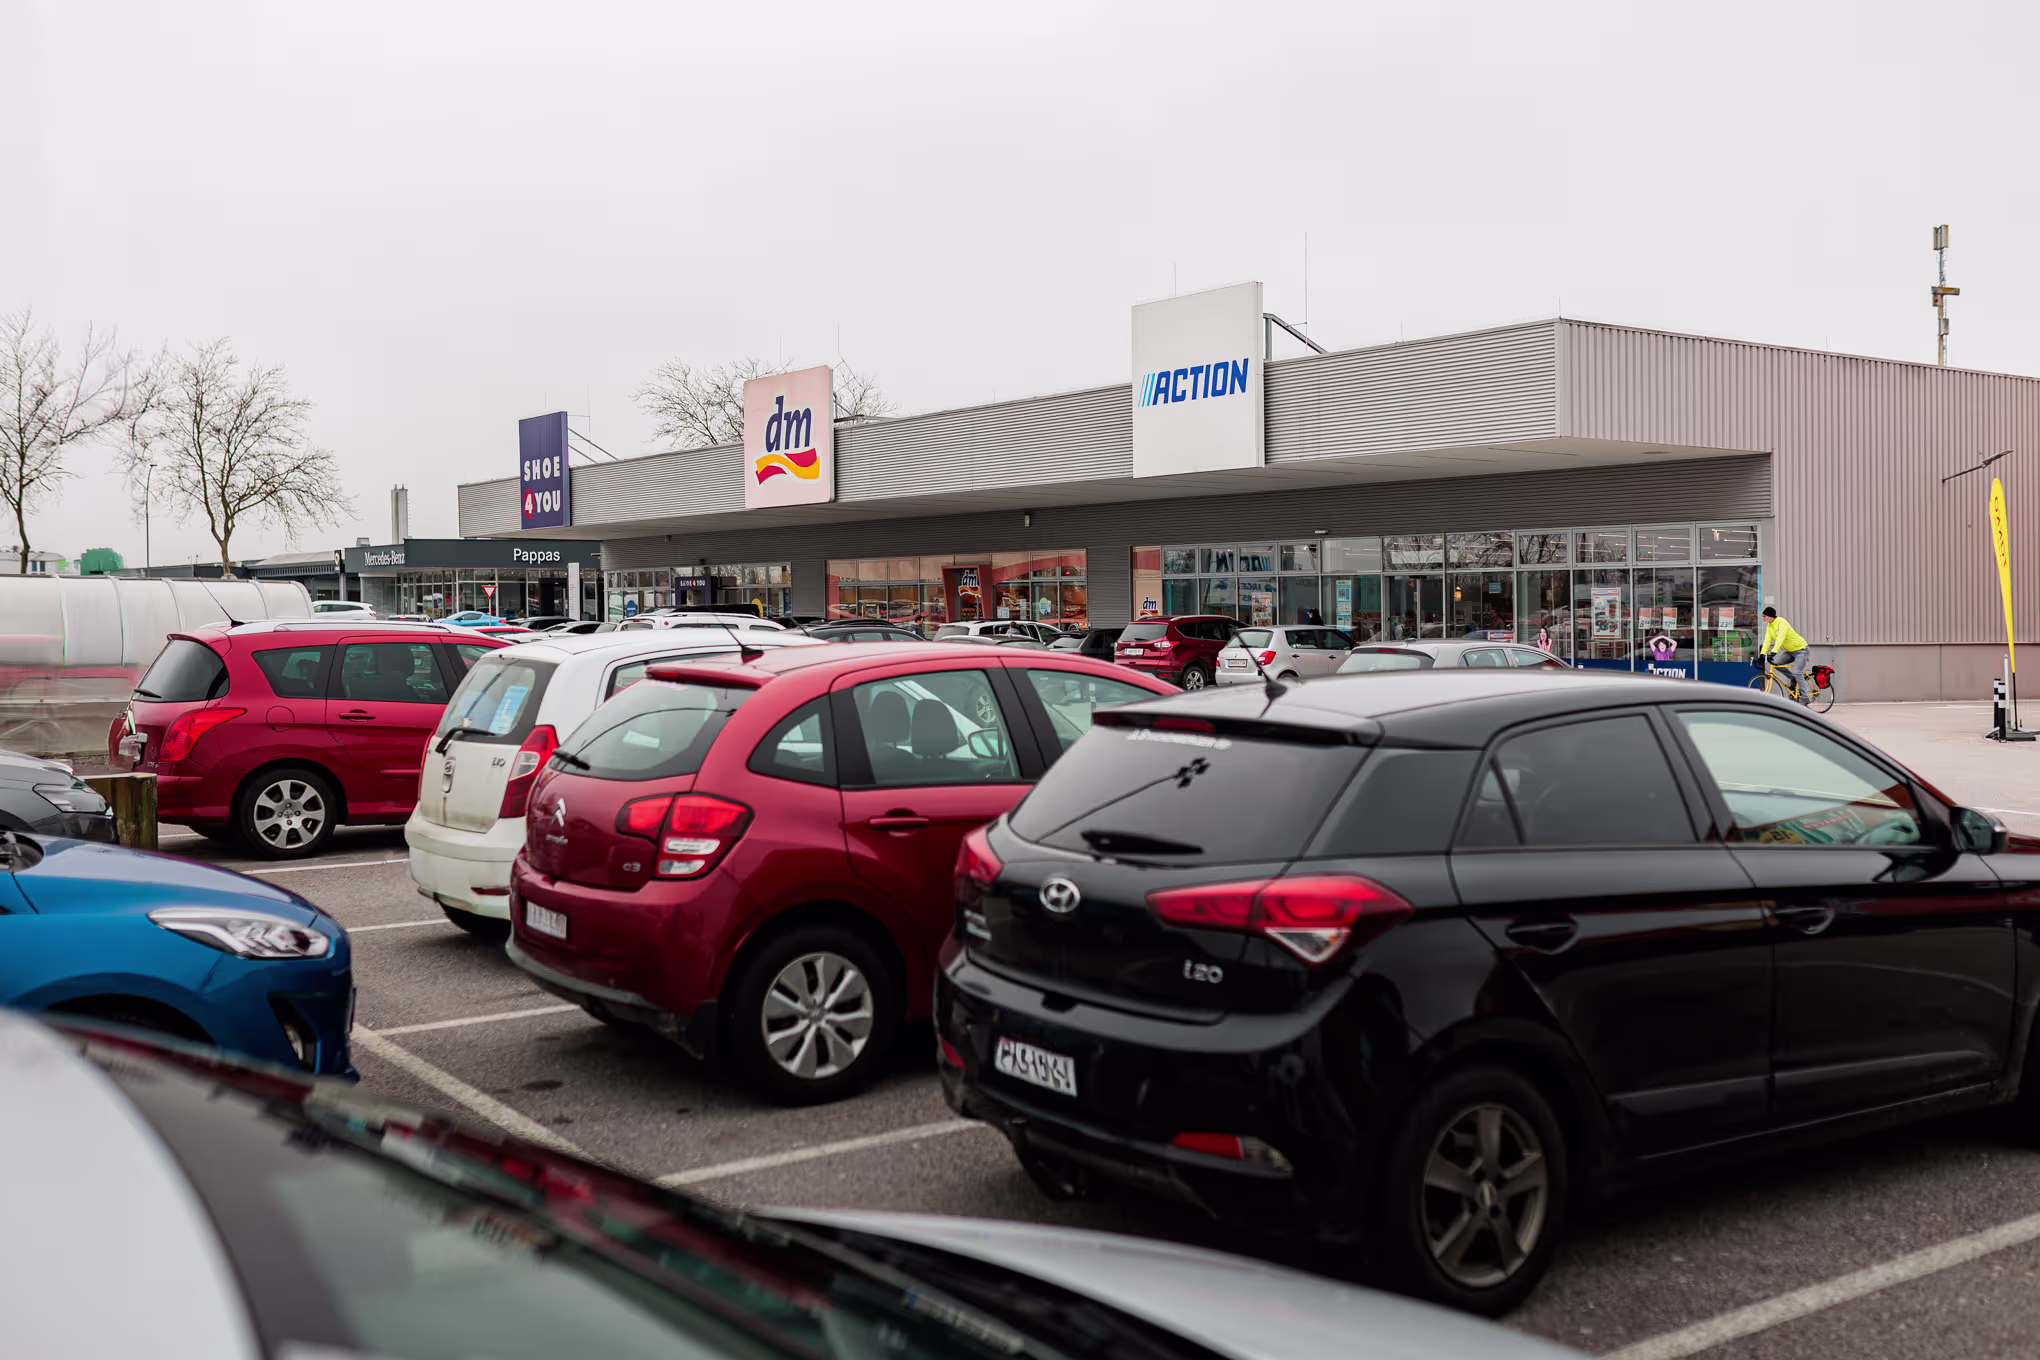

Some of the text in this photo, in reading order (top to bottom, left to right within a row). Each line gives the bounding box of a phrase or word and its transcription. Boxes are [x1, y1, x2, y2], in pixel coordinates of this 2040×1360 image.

[1152, 358, 1249, 406] ACTION
[765, 395, 812, 453] dm
[523, 456, 561, 482] SHOE
[364, 550, 406, 566] Mercedes-Benz
[513, 548, 561, 564] Pappas
[962, 570, 978, 586] dm
[1142, 596, 1157, 610] dm
